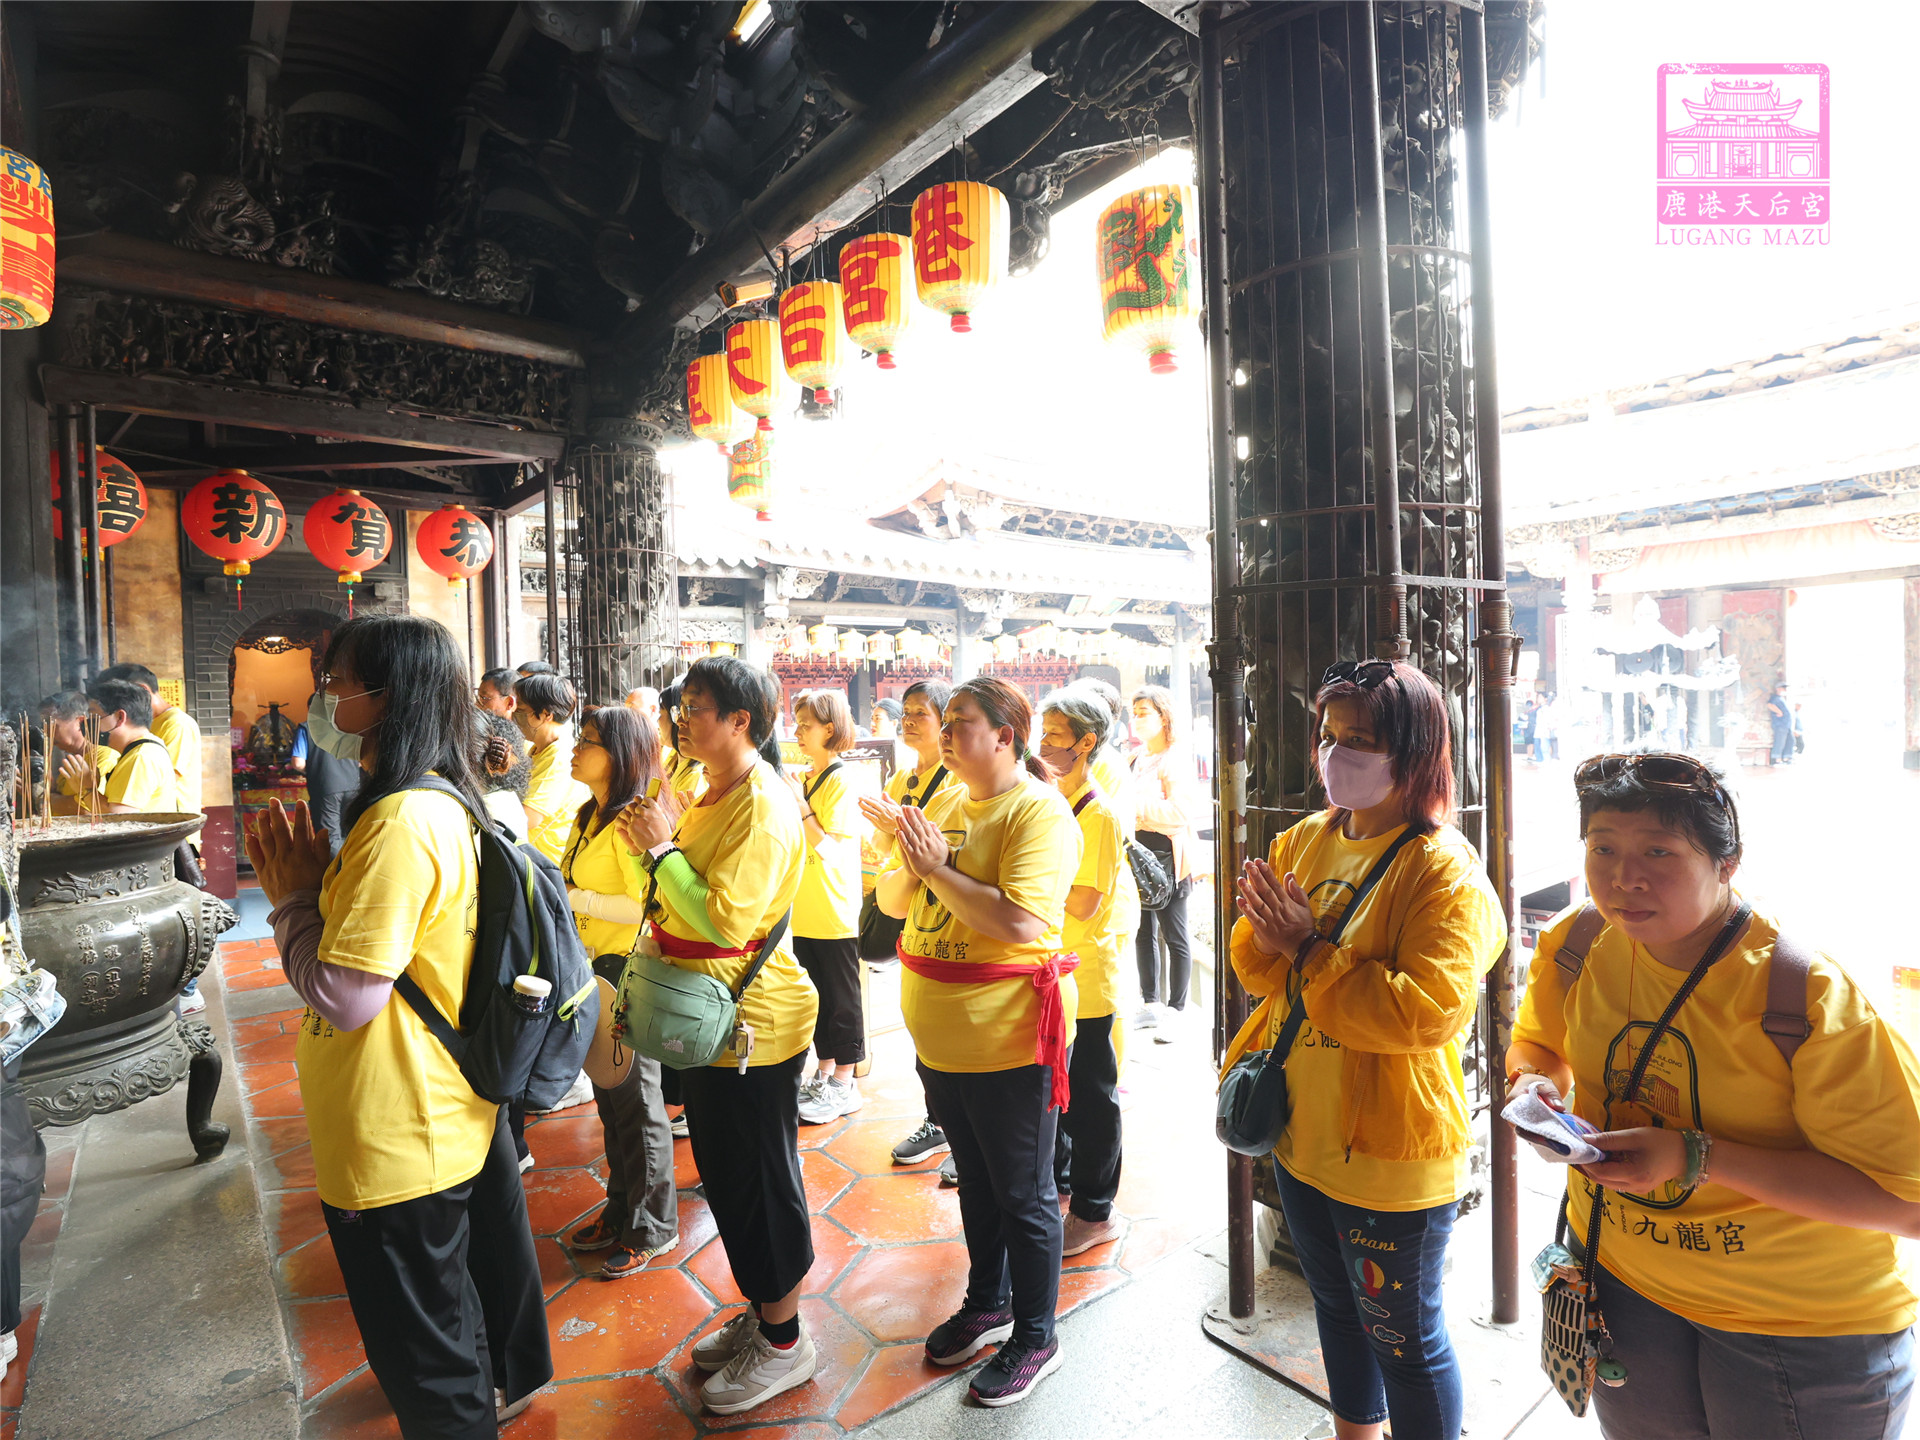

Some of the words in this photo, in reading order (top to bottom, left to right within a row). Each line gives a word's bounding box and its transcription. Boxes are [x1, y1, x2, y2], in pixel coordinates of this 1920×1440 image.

[839, 235, 903, 334] 宮
[210, 482, 283, 545] 新
[331, 502, 387, 559] 賀
[439, 517, 492, 567] 恭
[1350, 1229, 1398, 1251] Jeans
[1632, 1215, 1746, 1255] 九龍宮
